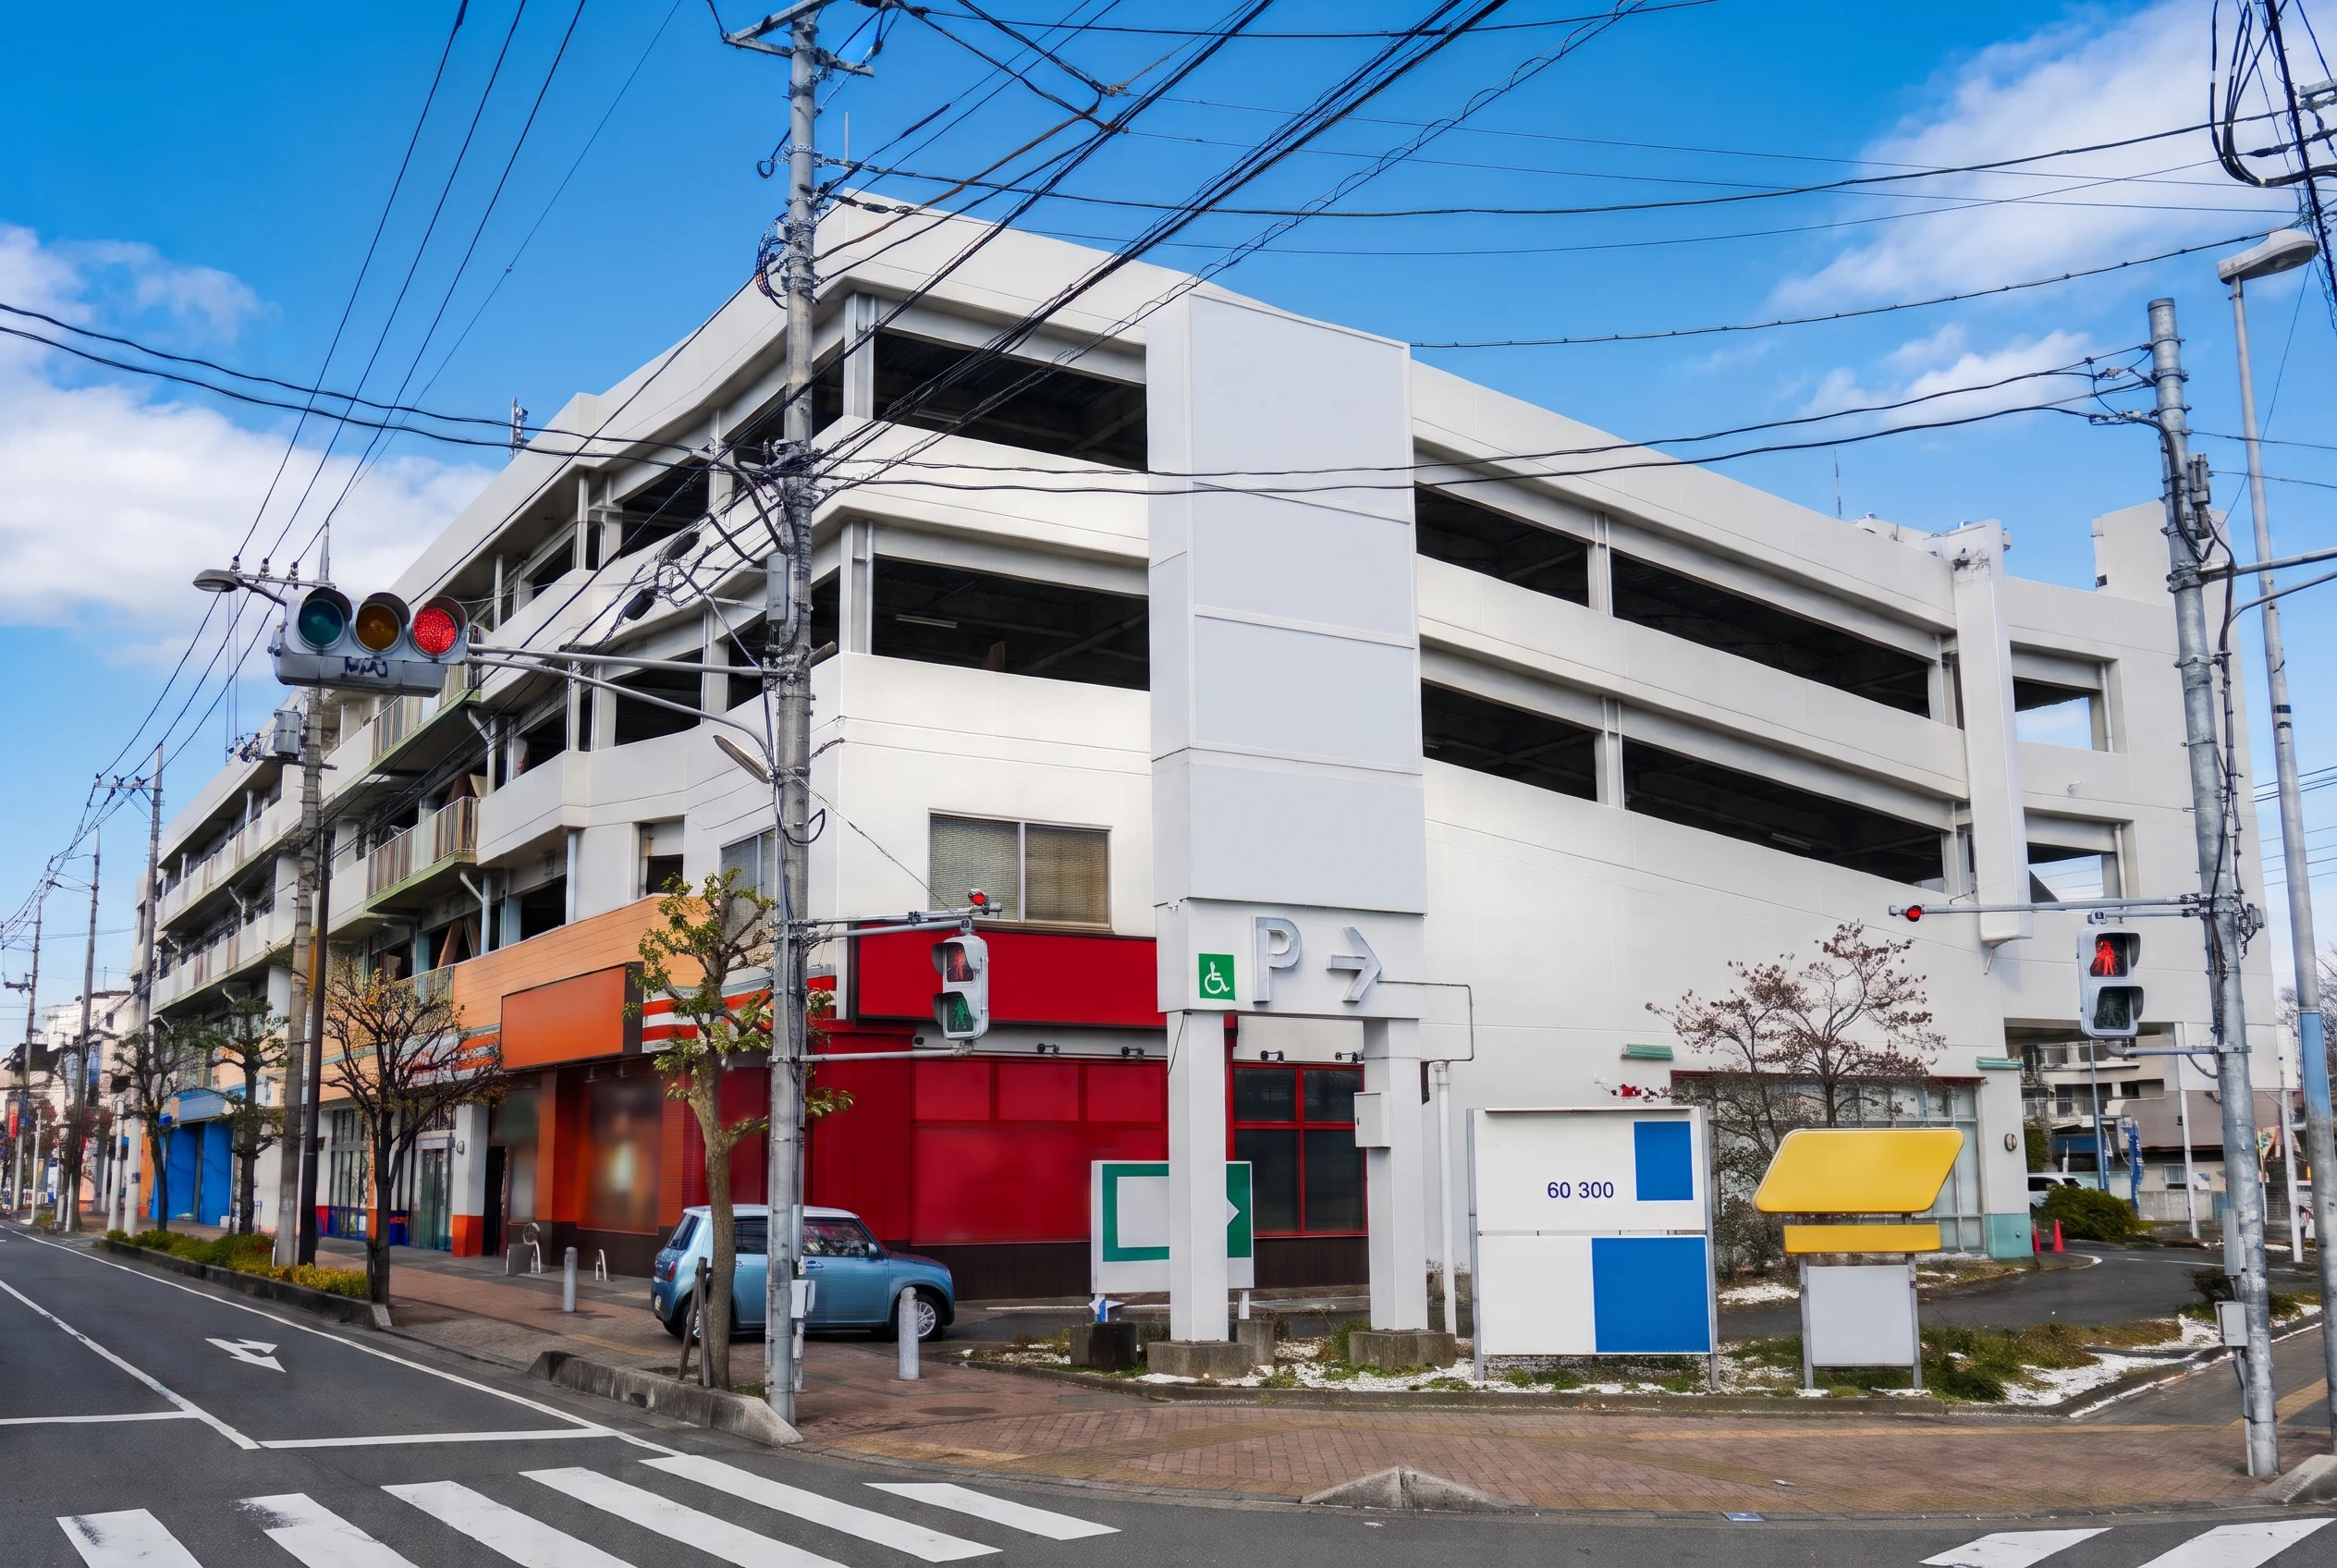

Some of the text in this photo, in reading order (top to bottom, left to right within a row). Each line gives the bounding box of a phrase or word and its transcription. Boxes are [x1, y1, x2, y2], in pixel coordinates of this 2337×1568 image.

[1253, 916, 1301, 1003] P
[1547, 1182, 1614, 1198] 60 300
